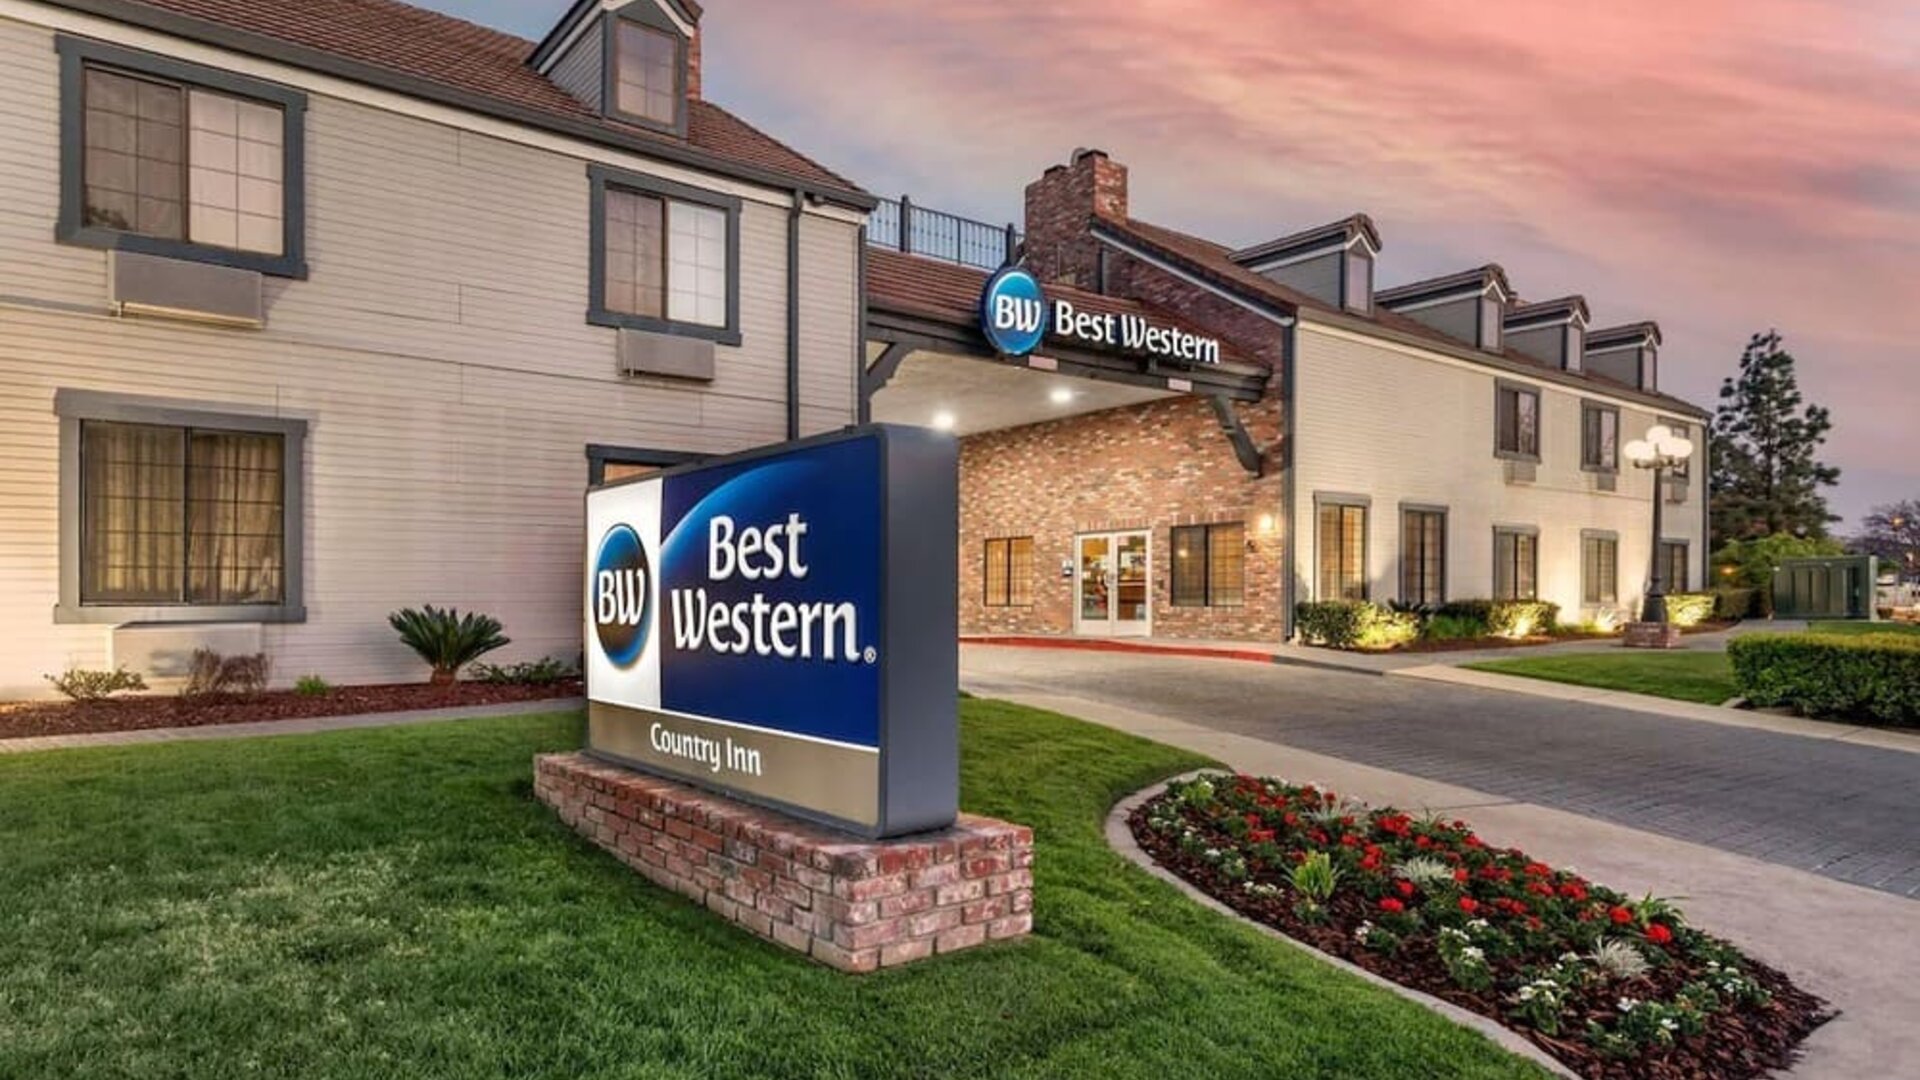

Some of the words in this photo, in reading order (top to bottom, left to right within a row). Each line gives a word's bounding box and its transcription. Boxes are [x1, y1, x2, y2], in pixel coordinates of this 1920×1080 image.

[994, 294, 1042, 334] BW
[1055, 300, 1117, 345] Best
[1120, 314, 1220, 364] Western
[708, 512, 809, 582] Best
[597, 568, 647, 626] BW
[650, 721, 721, 774] Country
[726, 737, 762, 777] Inn
